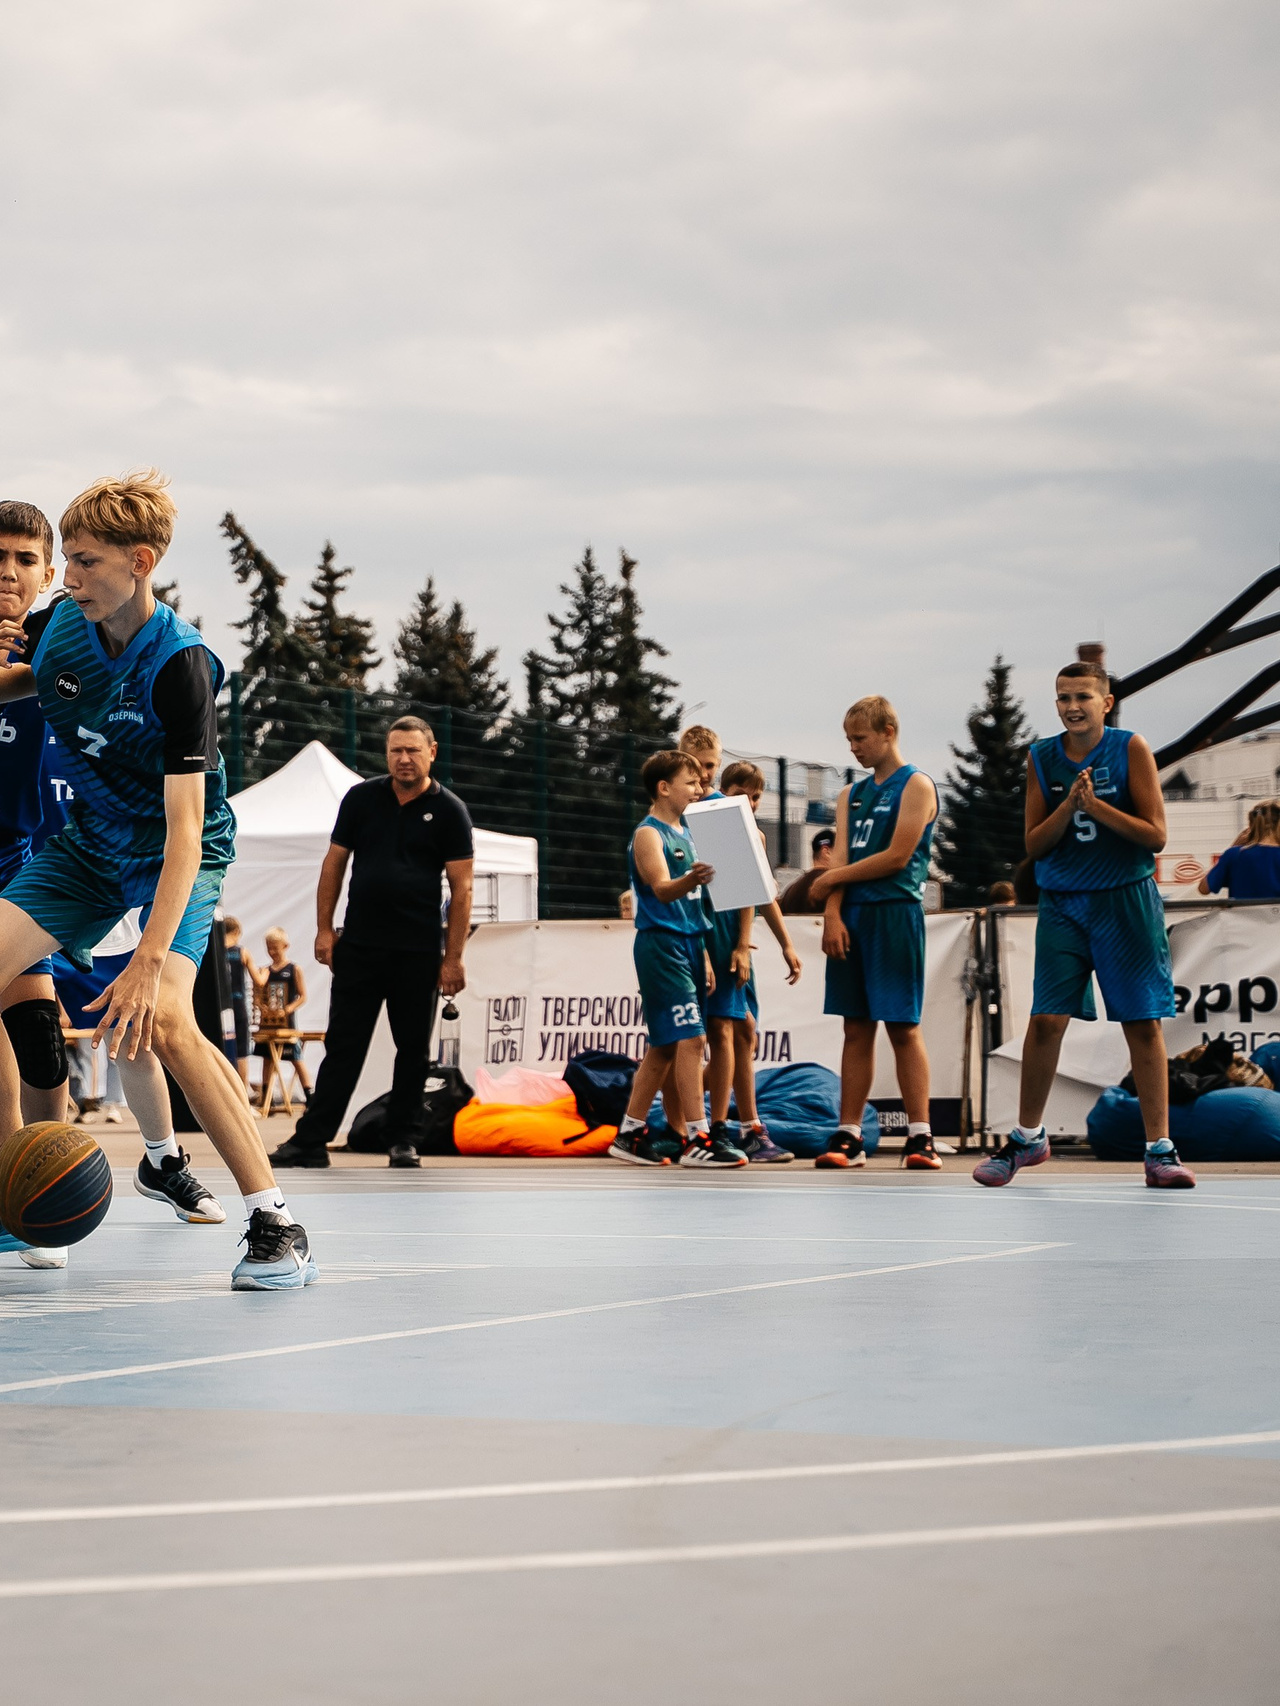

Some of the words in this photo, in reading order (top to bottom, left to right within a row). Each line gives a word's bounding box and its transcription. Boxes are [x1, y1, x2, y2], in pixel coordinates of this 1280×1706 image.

[58, 678, 78, 693] РФБ
[77, 725, 108, 758] 7
[1073, 810, 1097, 842] 5
[671, 1001, 701, 1028] 23
